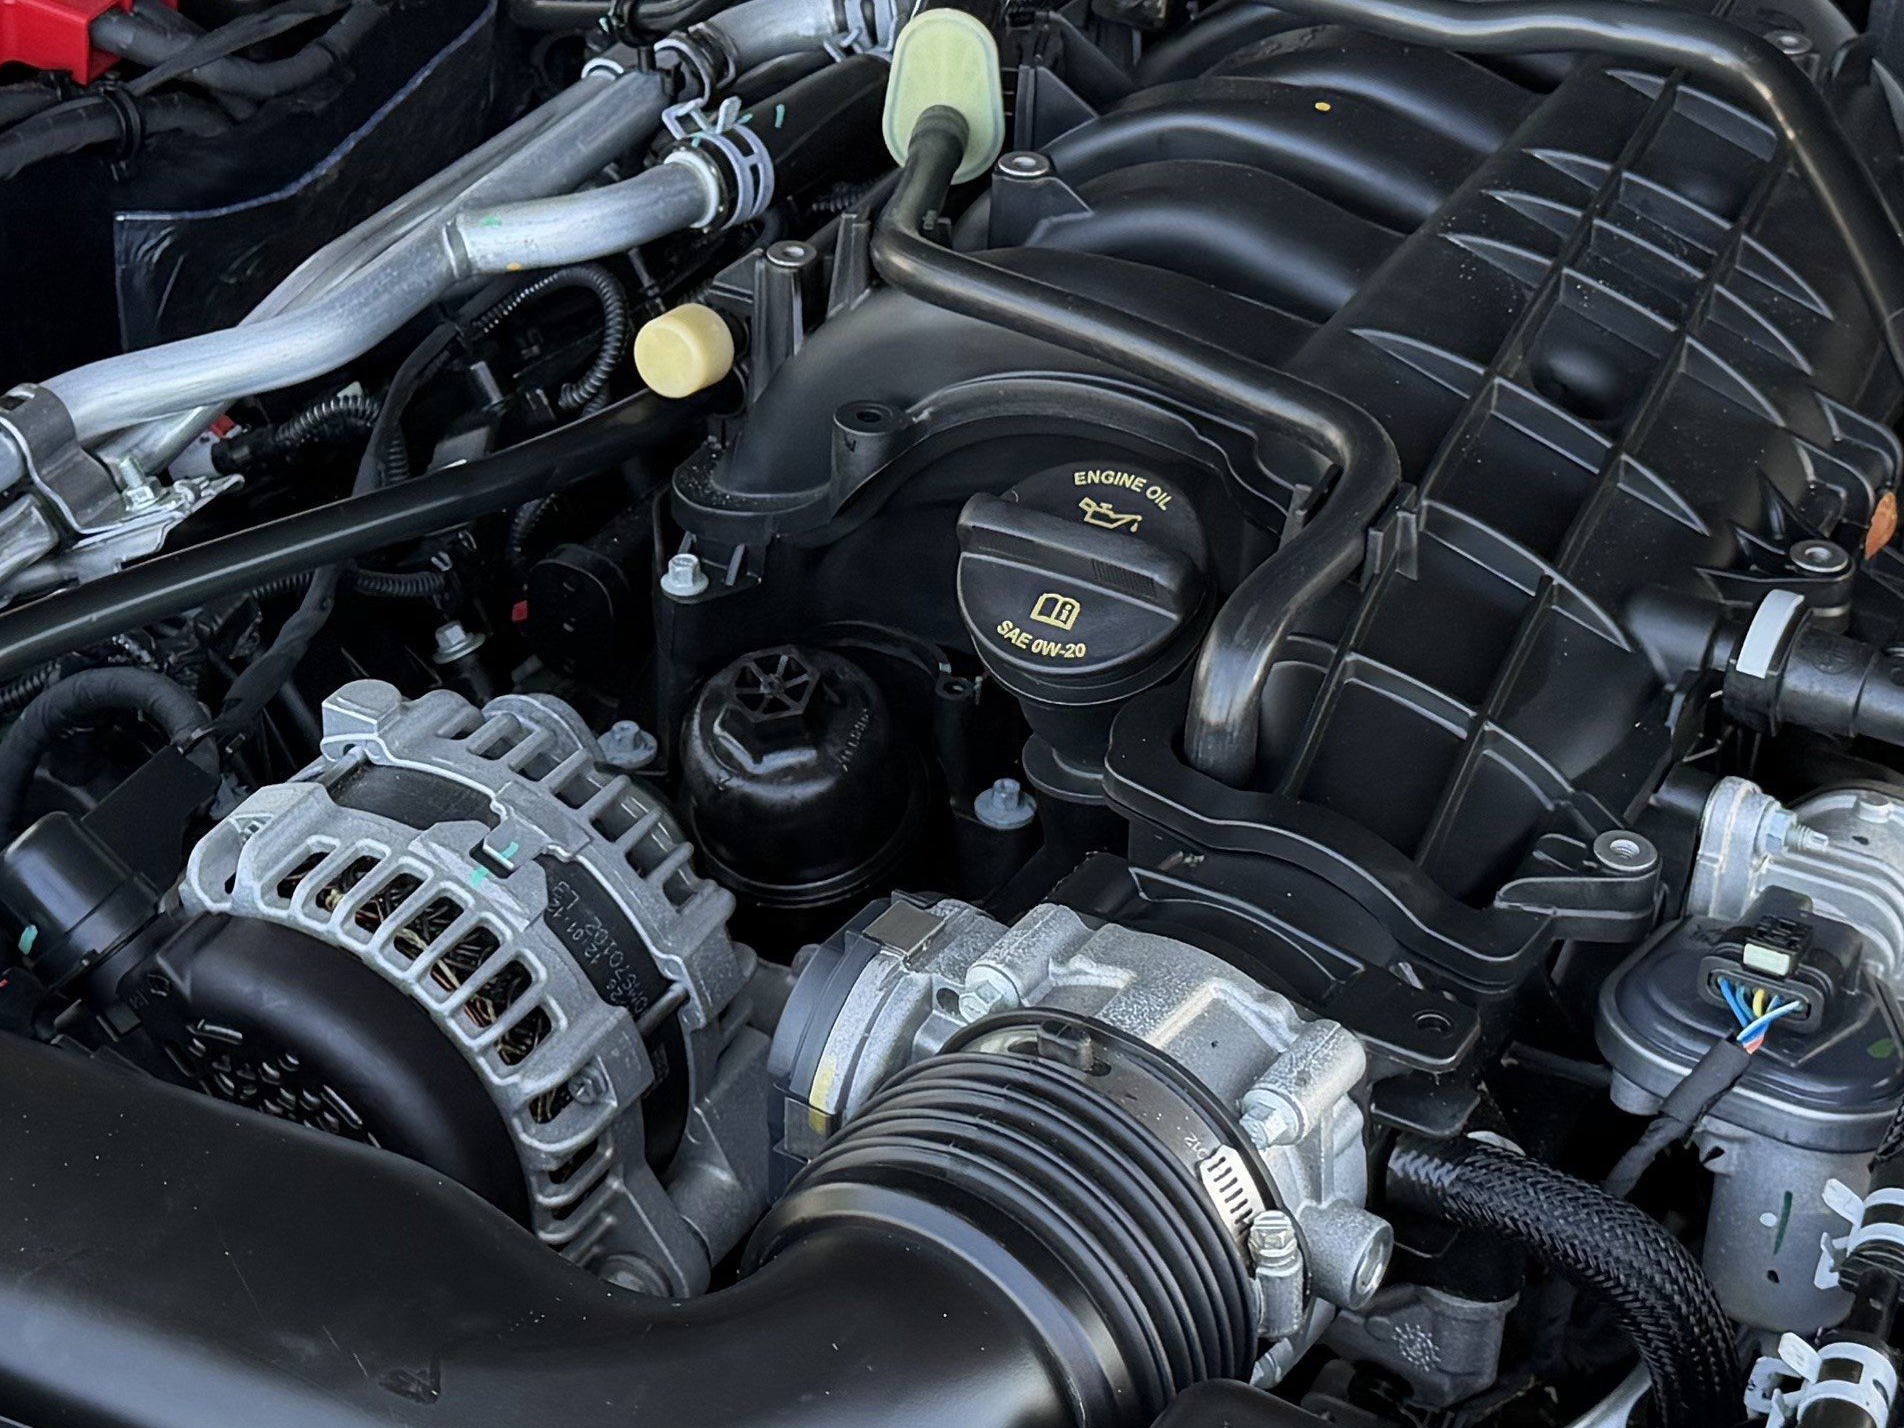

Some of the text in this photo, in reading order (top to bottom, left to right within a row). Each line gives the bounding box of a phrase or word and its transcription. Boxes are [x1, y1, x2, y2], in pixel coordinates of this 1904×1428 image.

[1074, 470, 1171, 511] ENGINE OIL
[996, 620, 1086, 660] SAE 0W-20
